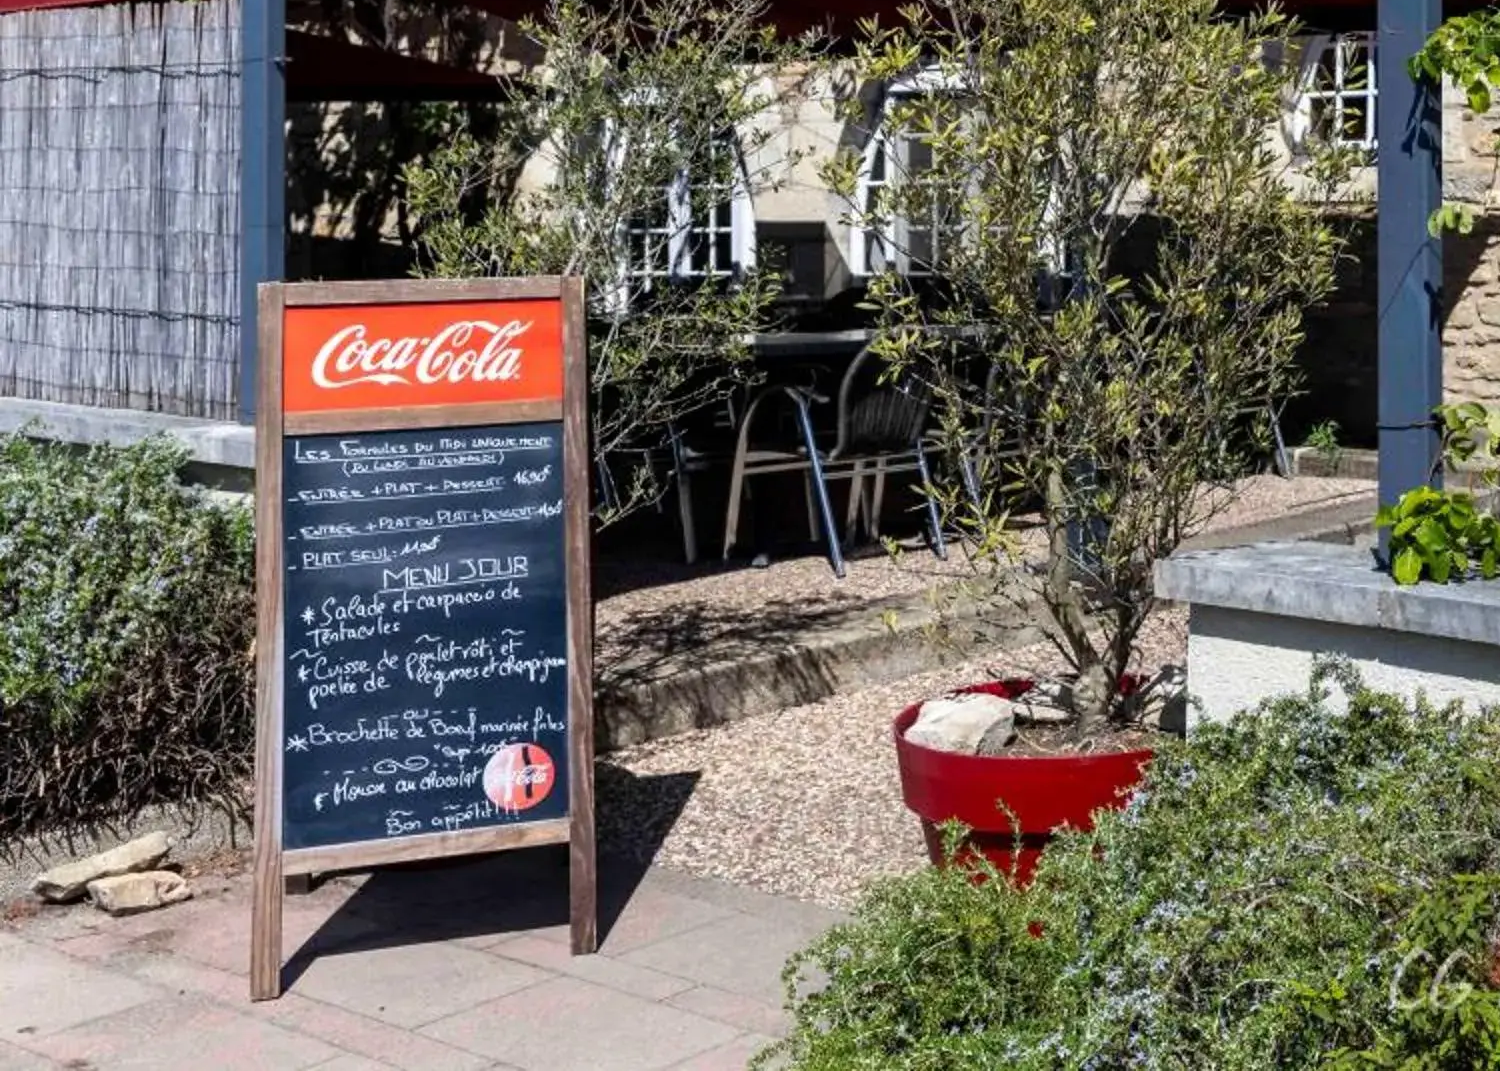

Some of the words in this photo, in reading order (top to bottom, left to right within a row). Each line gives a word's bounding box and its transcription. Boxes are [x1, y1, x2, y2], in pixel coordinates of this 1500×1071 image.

[310, 320, 534, 389] Coca-Cola
[383, 562, 450, 590] MENU
[458, 556, 529, 581] JOUR
[320, 595, 386, 627] Salade
[393, 589, 415, 613] et
[501, 580, 523, 601] de
[377, 649, 400, 671] de
[500, 638, 523, 657] et
[363, 670, 392, 692] de
[405, 720, 427, 738] de
[385, 817, 421, 835] Bon
